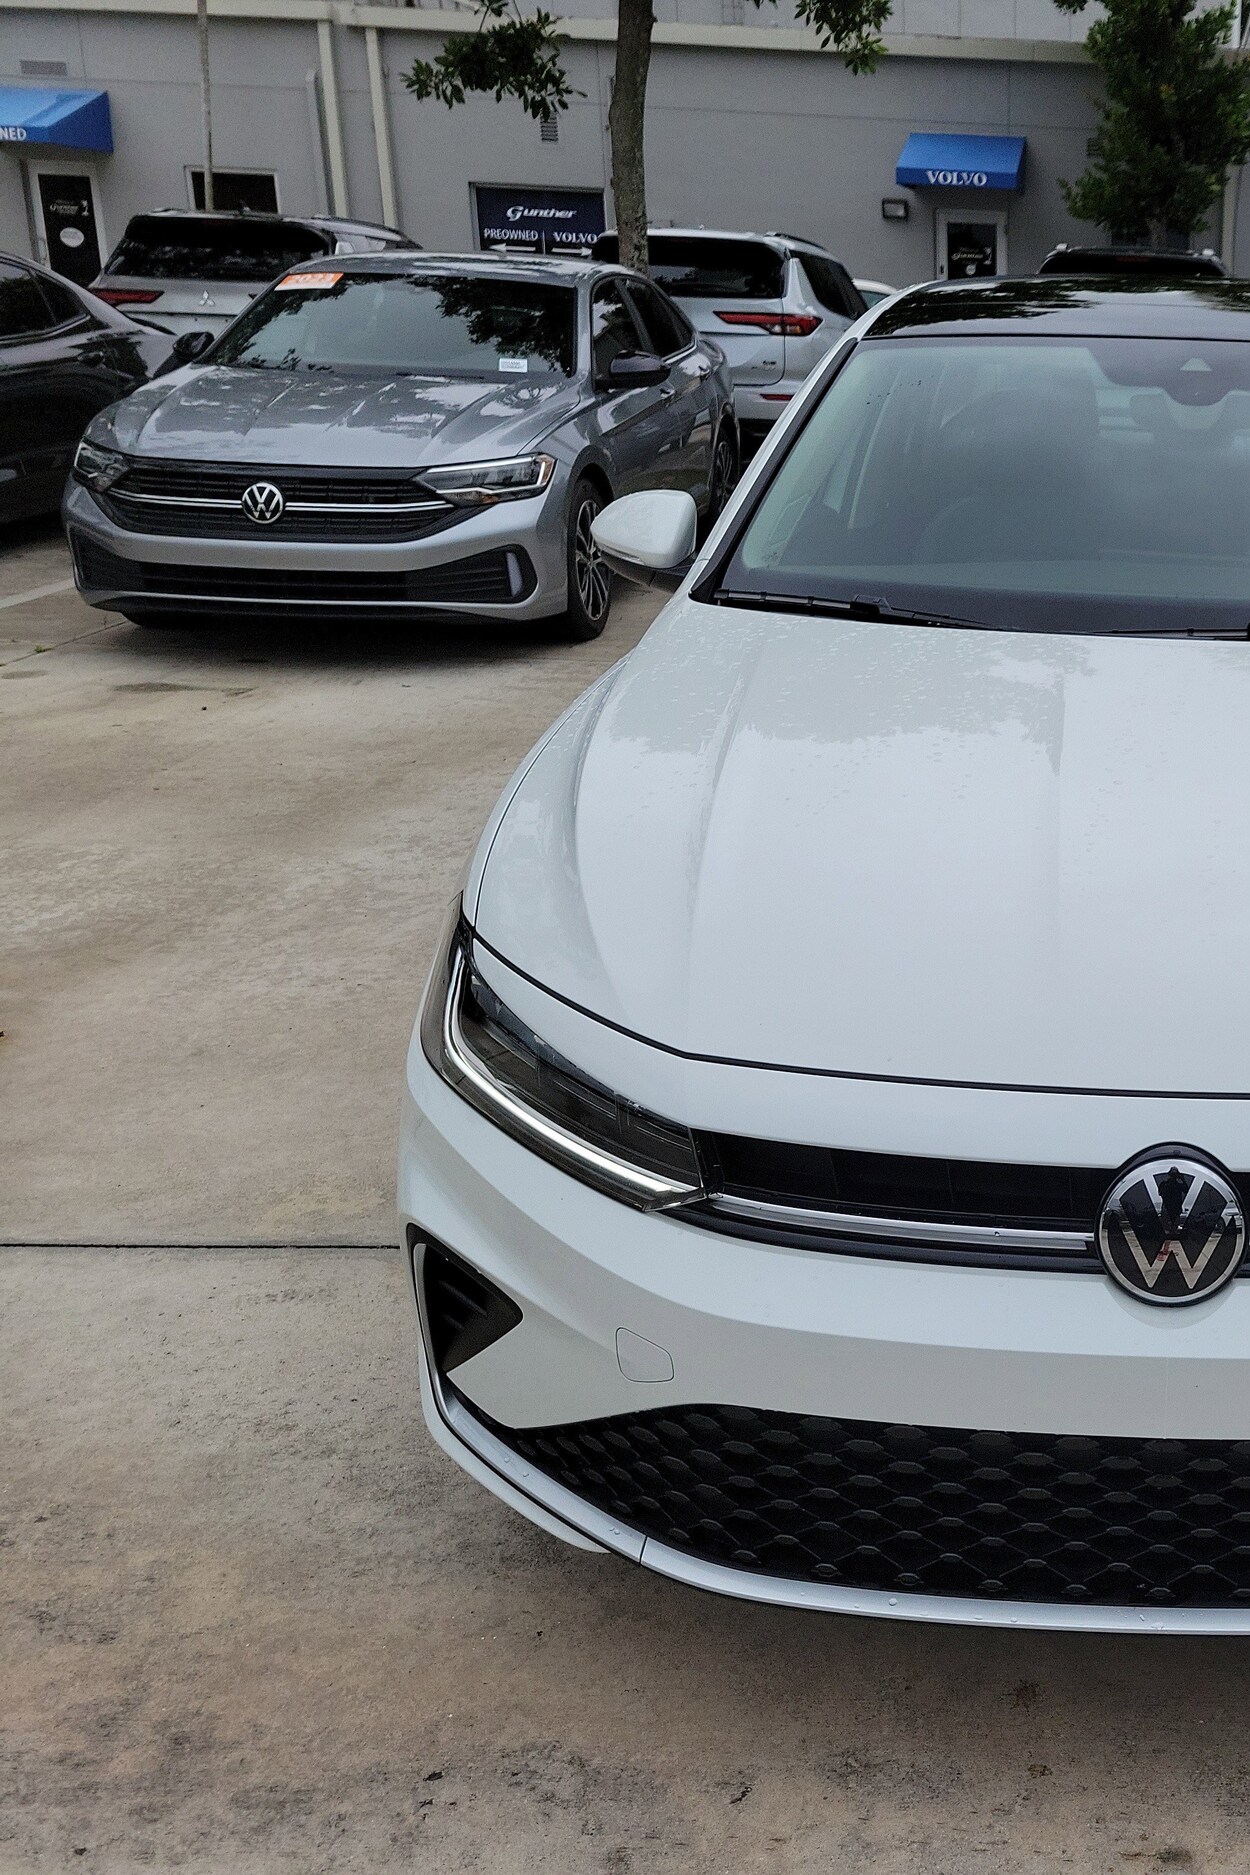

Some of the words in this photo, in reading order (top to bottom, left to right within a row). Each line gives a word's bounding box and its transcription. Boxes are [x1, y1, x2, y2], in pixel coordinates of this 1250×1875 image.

[926, 170, 988, 187] VOLVO
[506, 205, 578, 222] Gunther
[483, 227, 539, 241] PREOWNED
[553, 231, 600, 244] VOLVO
